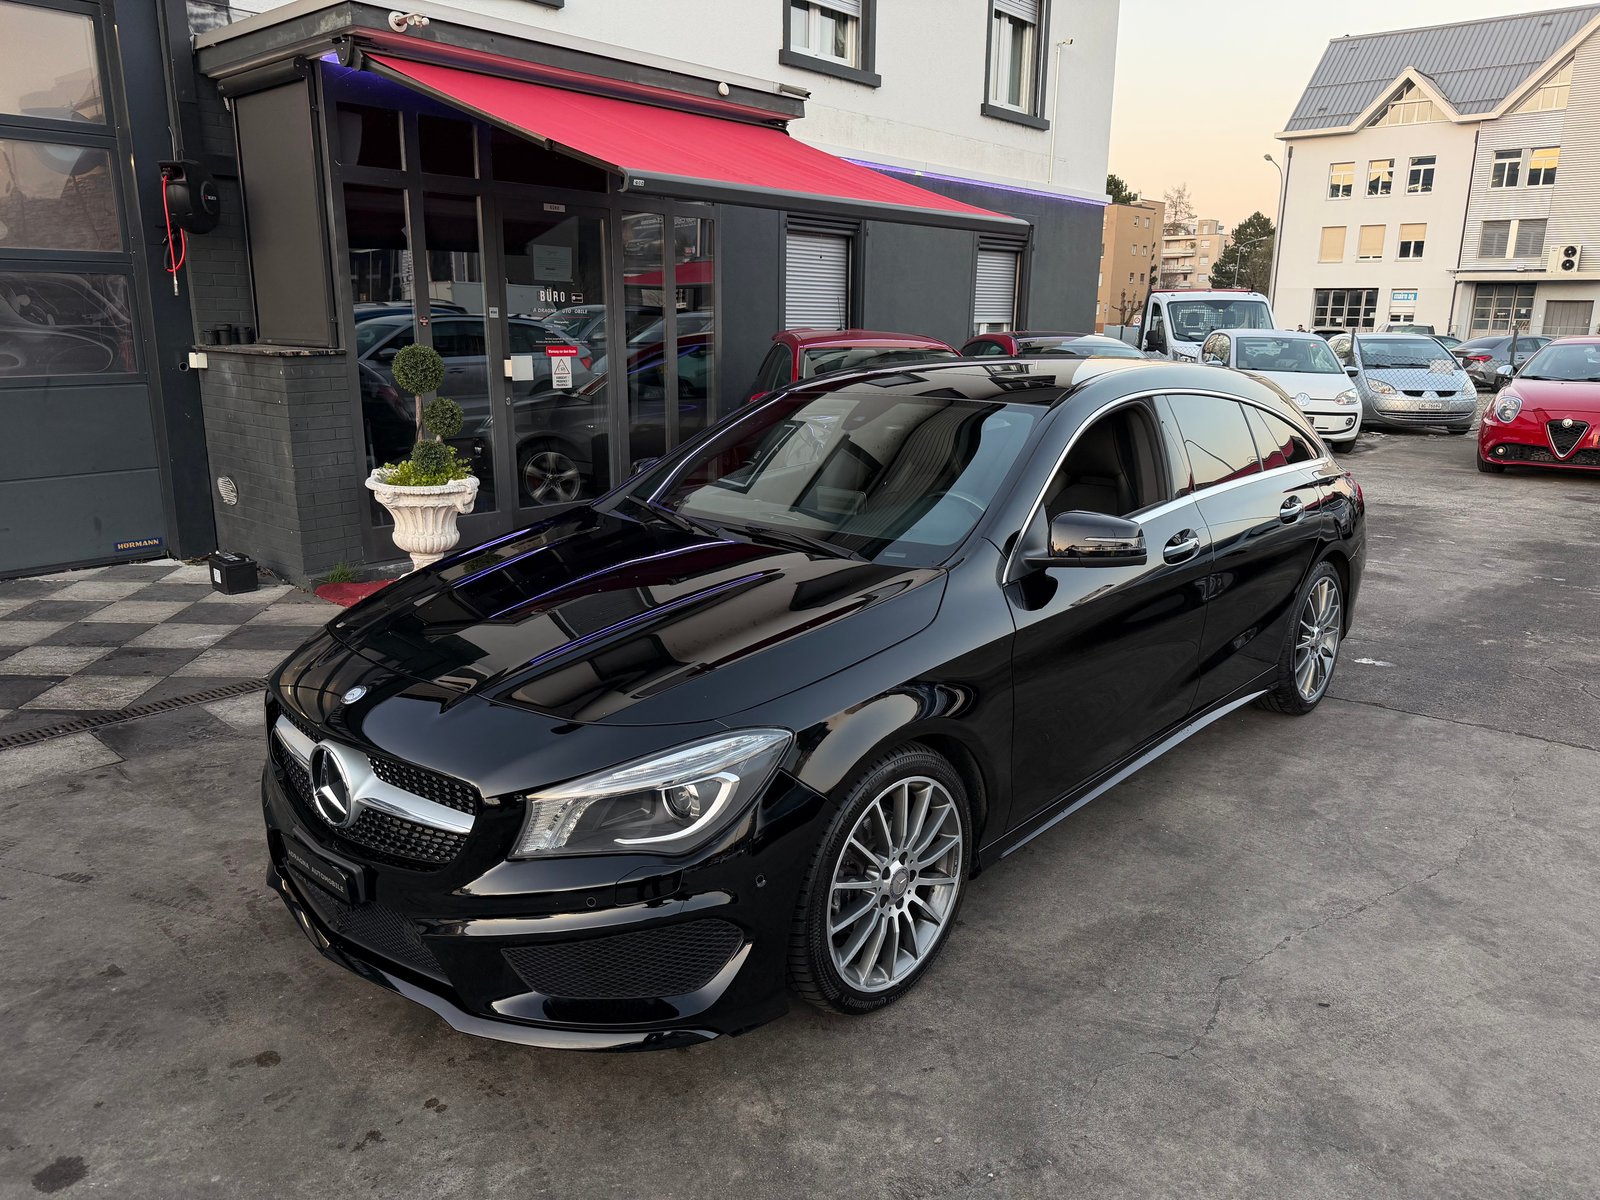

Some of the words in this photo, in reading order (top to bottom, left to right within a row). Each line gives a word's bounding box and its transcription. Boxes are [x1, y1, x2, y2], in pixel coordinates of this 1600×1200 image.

[540, 288, 566, 302] BÜRO
[288, 849, 310, 870] ADRAGNA
[311, 866, 345, 893] AUTOMOBILE
